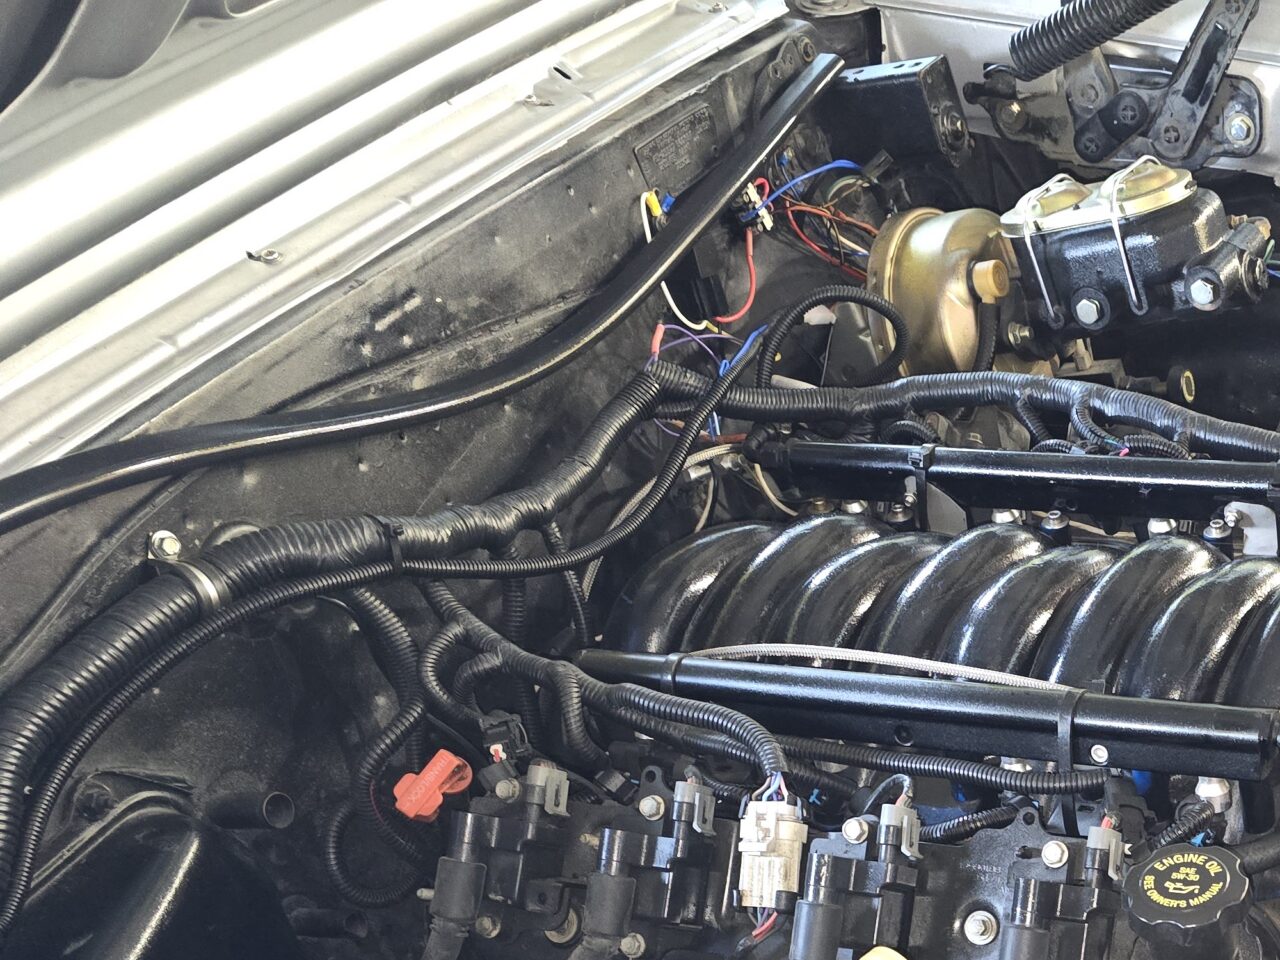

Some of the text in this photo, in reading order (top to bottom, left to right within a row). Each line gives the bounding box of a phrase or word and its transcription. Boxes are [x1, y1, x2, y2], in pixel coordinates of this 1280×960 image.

[1154, 853, 1223, 877] ENGINE OIL
[1171, 872, 1200, 881] 5W-30
[1143, 875, 1223, 908] SEE OWNER'S MANUAL
